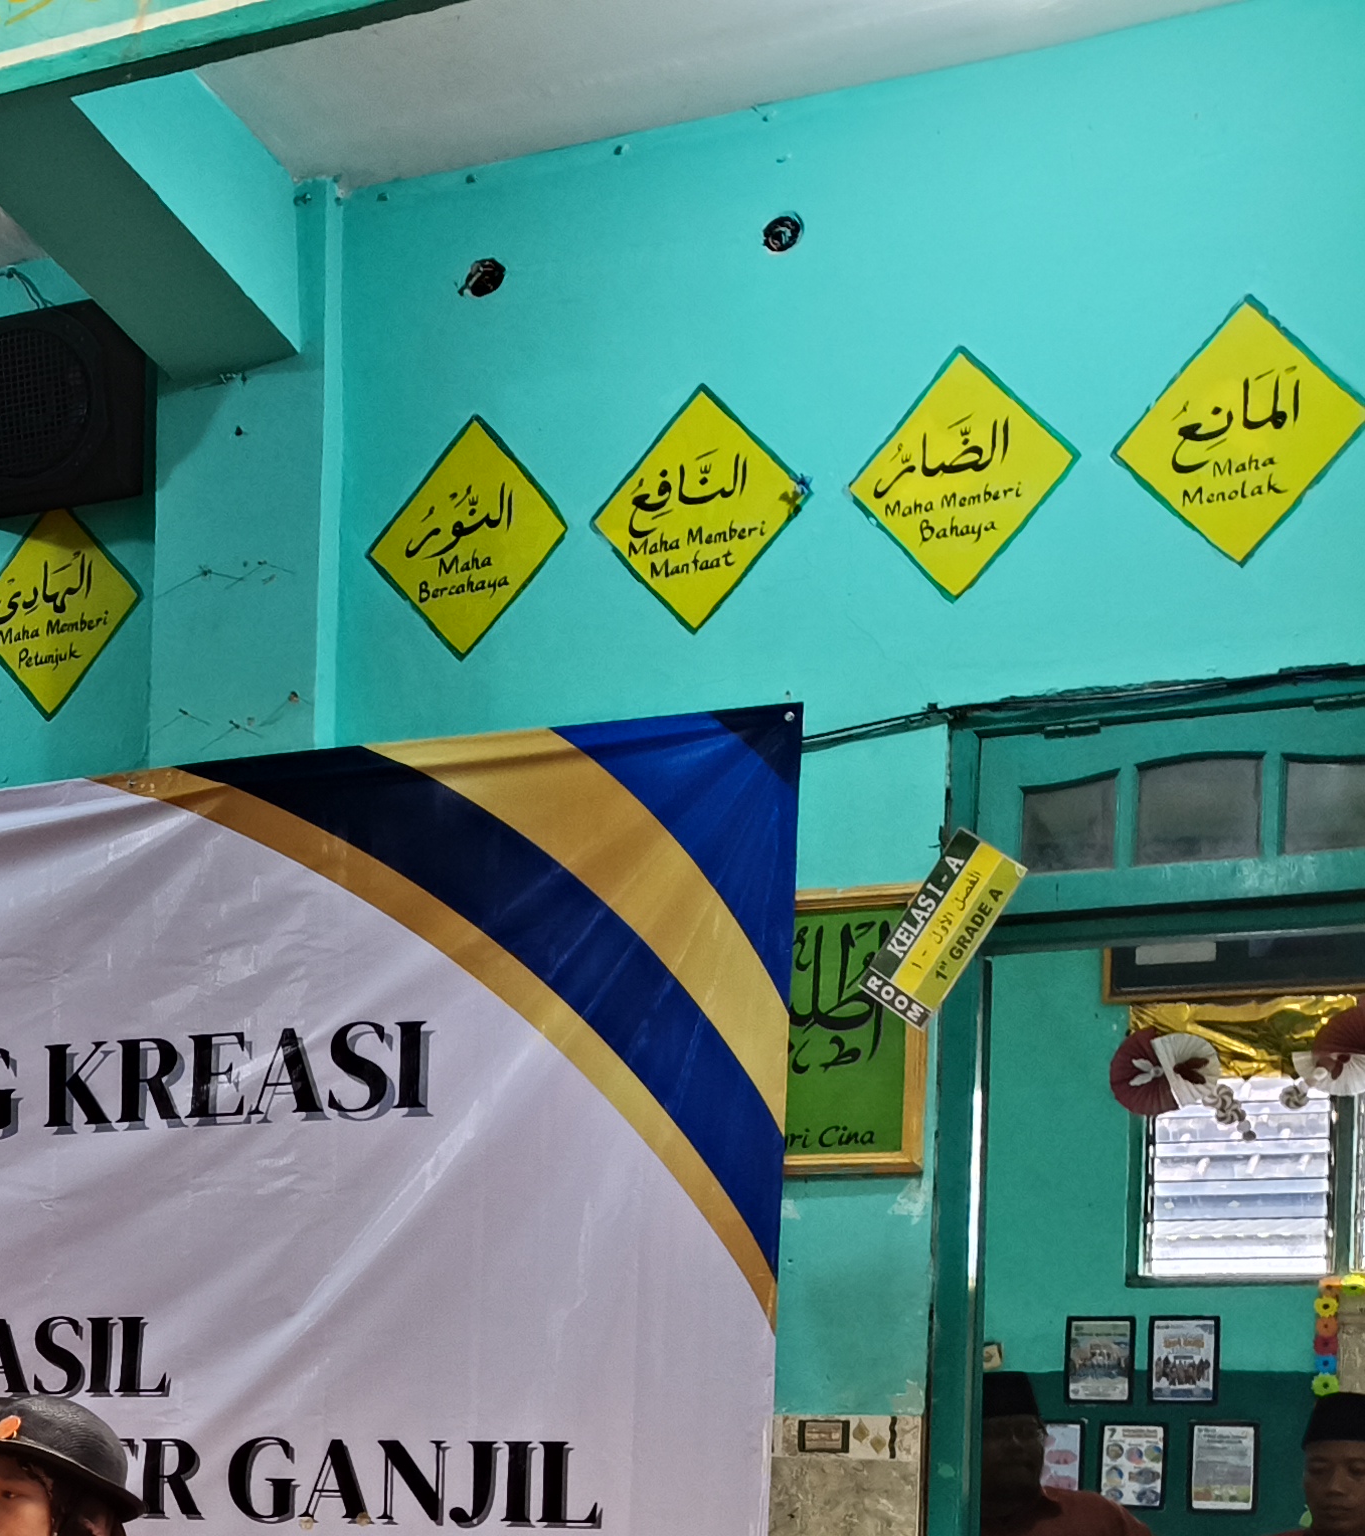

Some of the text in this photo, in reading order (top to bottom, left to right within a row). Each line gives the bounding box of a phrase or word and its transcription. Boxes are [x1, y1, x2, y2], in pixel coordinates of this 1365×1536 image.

[1212, 454, 1277, 479] Maha
[884, 481, 1022, 518] Maha Memberi
[1182, 473, 1288, 507] Menolak
[627, 520, 766, 559] Maha Memberi
[918, 517, 998, 547] Bahaya
[438, 548, 492, 578] Maha
[649, 549, 735, 580] Manfaat
[418, 573, 510, 603] Bercahaya
[46, 610, 109, 635] Memberi
[17, 643, 82, 670] Petunjuk
[886, 894, 937, 960] KELAS
[944, 854, 966, 876] A
[948, 910, 994, 961] GRADE
[991, 886, 1004, 904] A
[866, 974, 925, 1023] ROOM
[45, 1019, 438, 1135] KREASI
[818, 1124, 876, 1150] Cina
[228, 1436, 603, 1530] GANJIL
